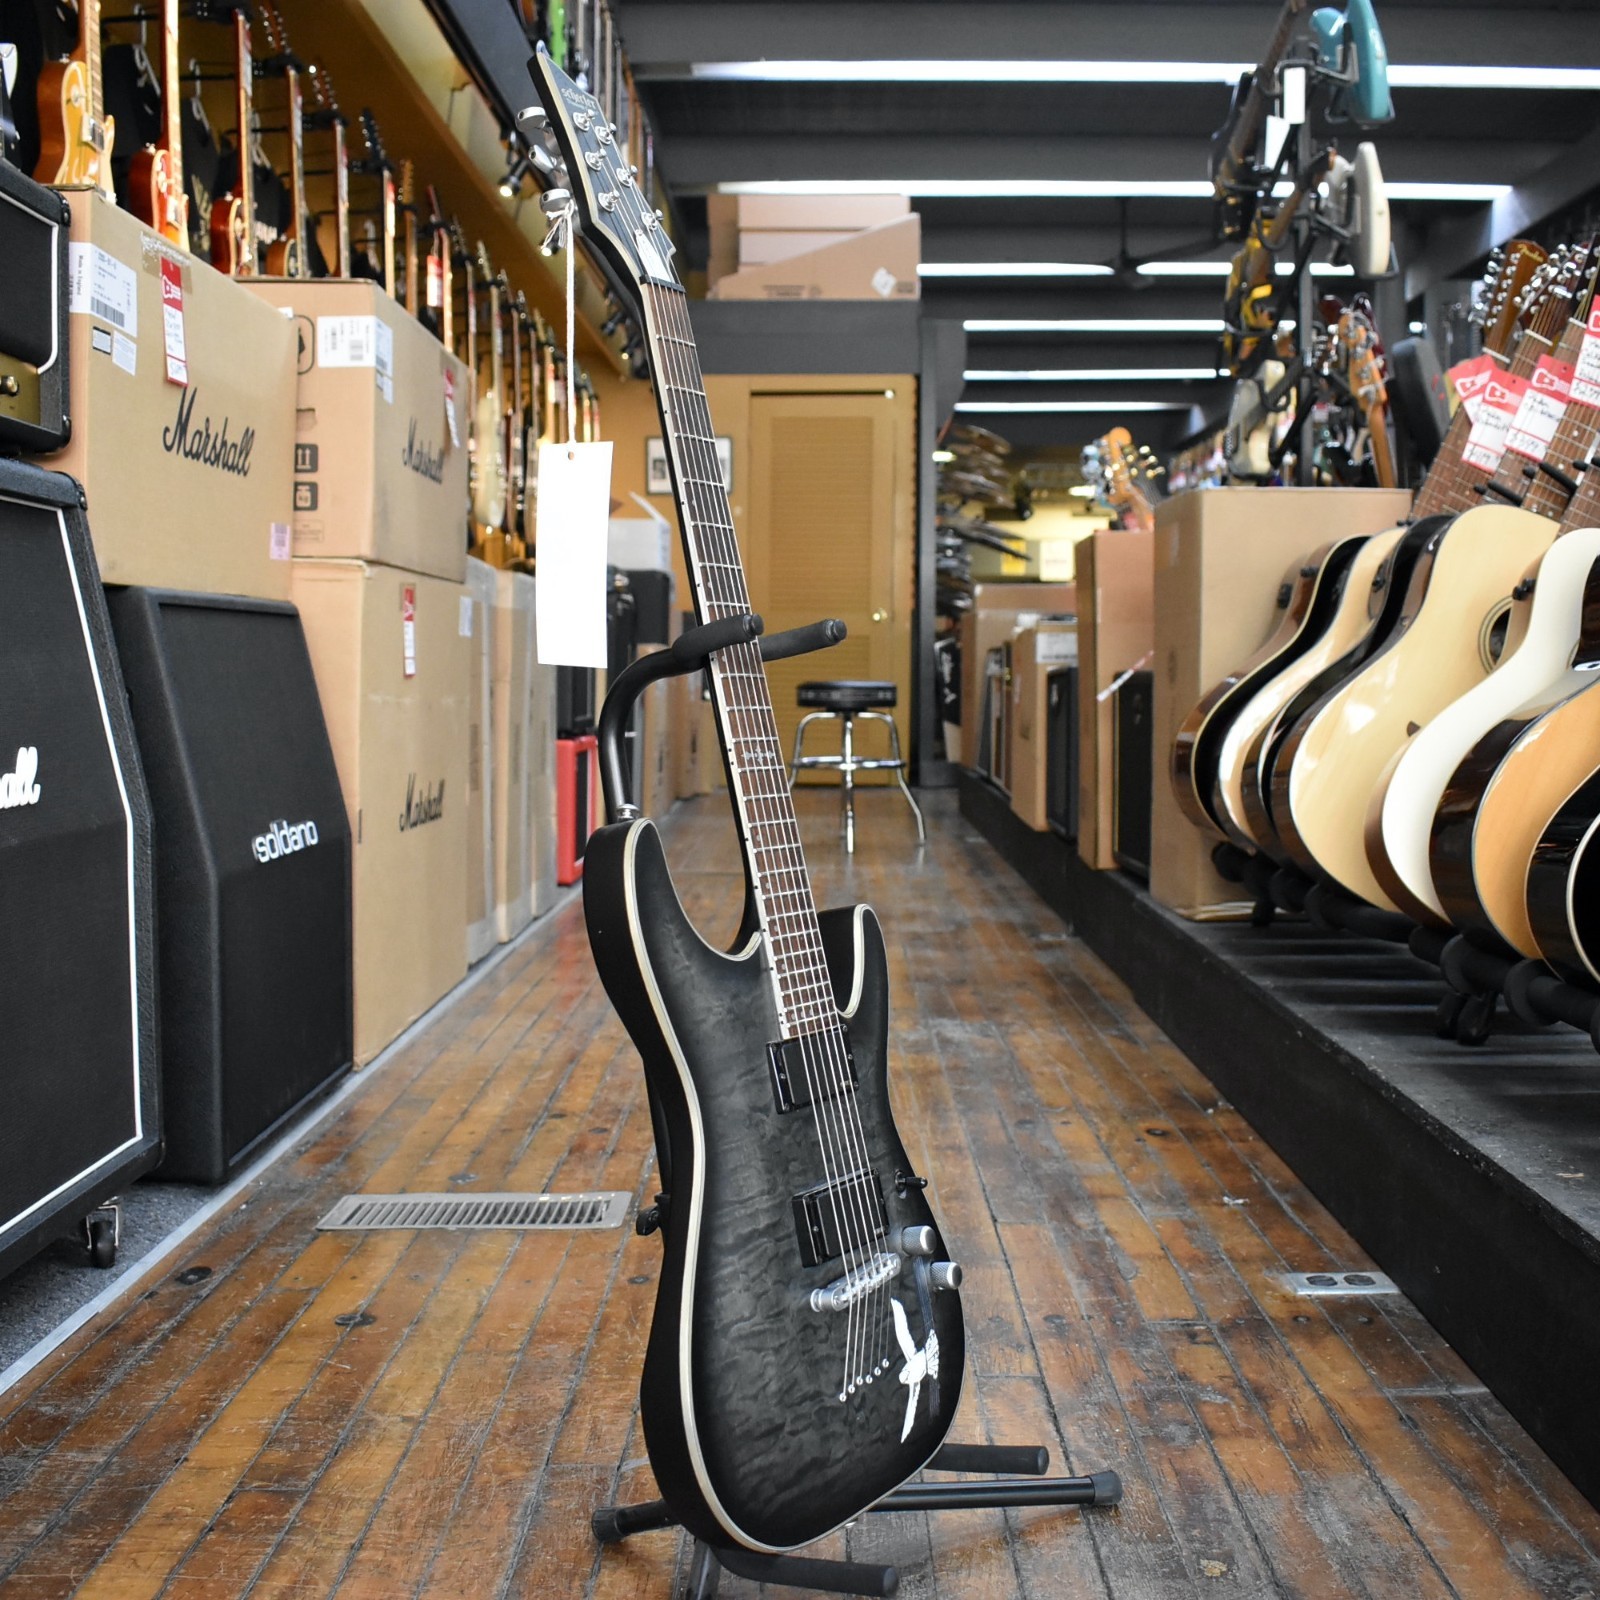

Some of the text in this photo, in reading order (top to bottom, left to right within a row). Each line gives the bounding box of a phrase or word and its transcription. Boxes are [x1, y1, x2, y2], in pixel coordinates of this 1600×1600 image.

[163, 386, 255, 477] Marshall
[402, 416, 445, 485] Marshall
[0, 746, 41, 809] all
[399, 772, 445, 832] Marshall
[252, 819, 319, 864] soldano
